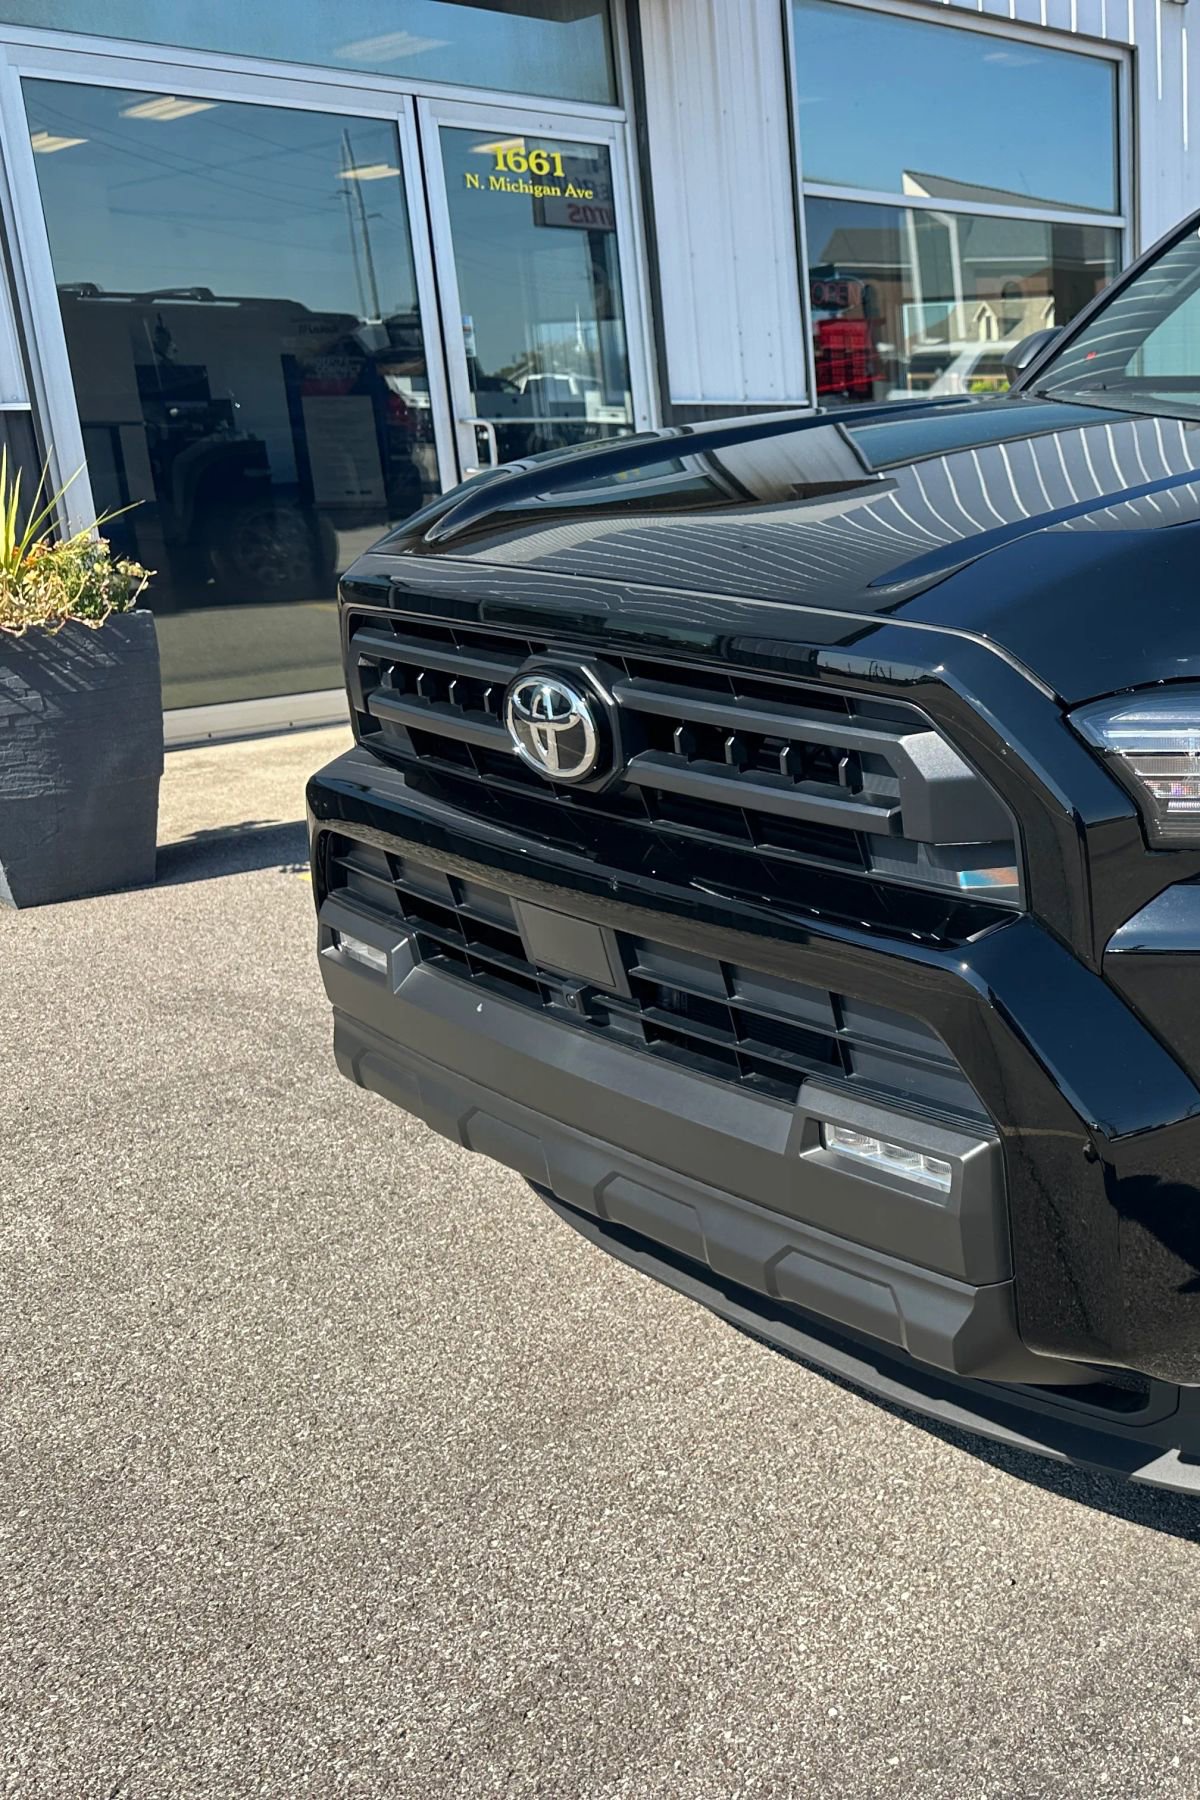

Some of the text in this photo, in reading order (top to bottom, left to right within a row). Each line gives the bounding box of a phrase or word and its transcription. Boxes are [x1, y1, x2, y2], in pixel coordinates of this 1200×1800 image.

[495, 147, 565, 177] 1661
[465, 173, 593, 199] N. Michigan Ave
[811, 282, 860, 305] OPEN
